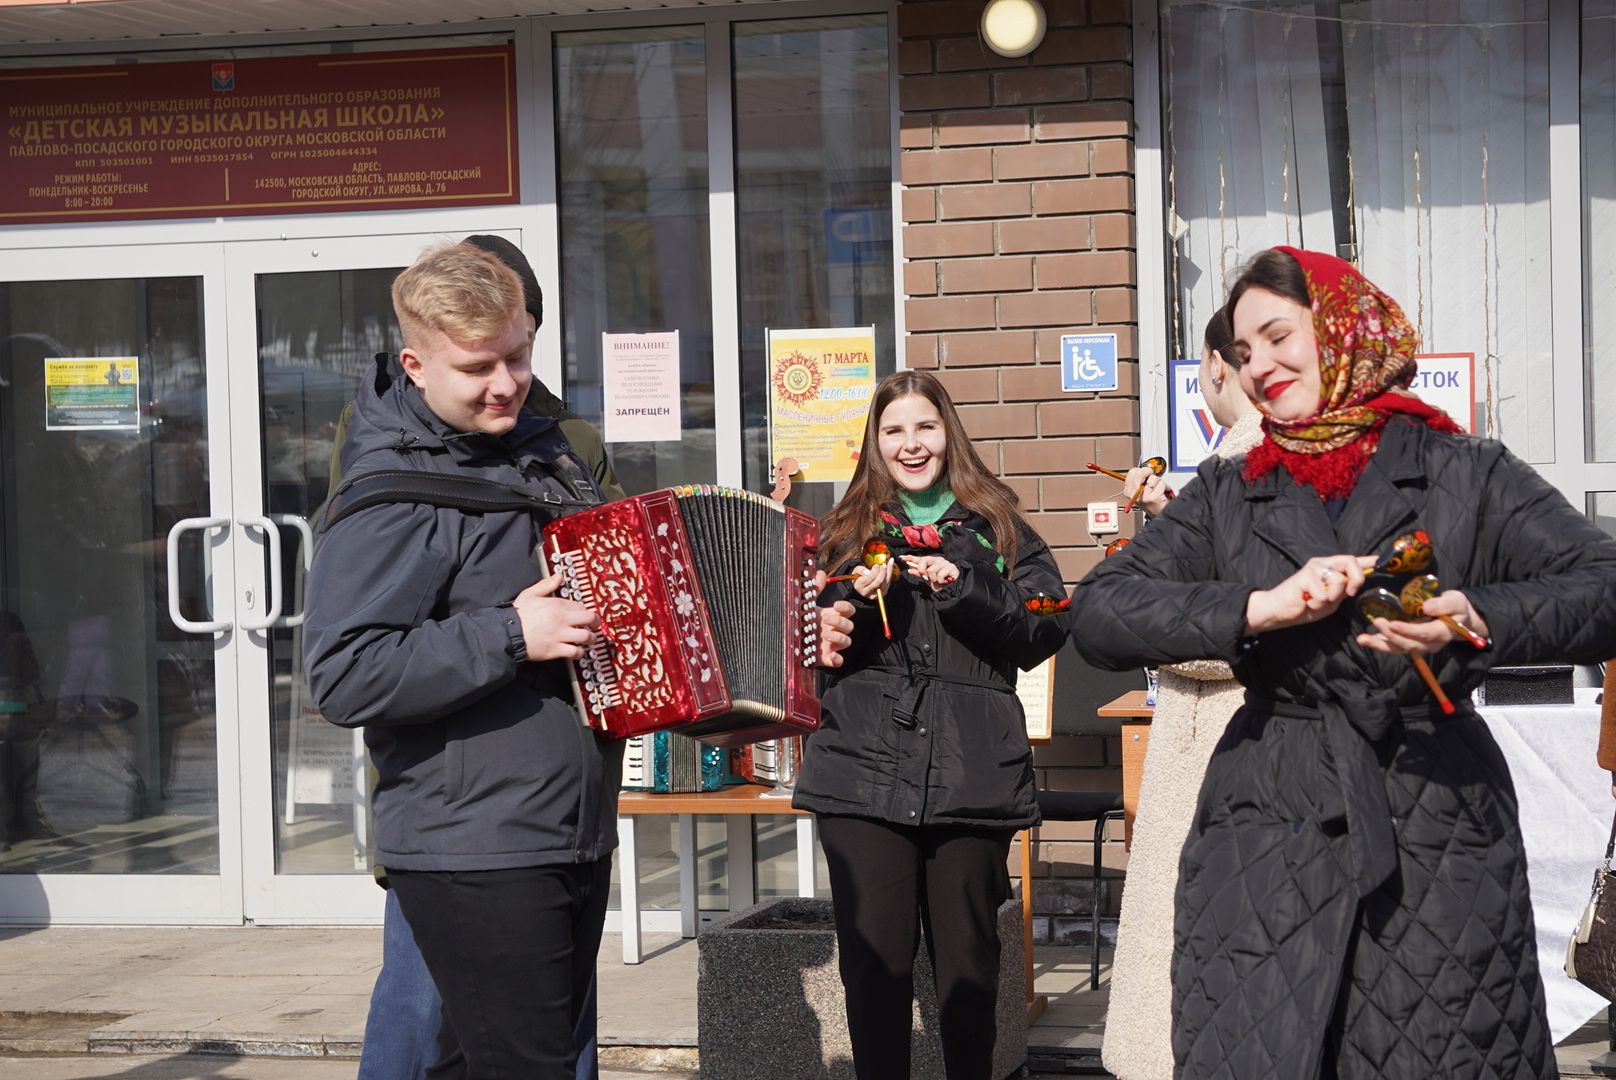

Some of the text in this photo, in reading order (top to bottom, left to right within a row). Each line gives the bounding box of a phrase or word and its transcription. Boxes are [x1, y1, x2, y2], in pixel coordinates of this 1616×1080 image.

[9, 87, 441, 118] МУНИЦИПАЛЬНОЕ УЧРЕЖДЕНИЕ ДОПОЛНИТЕЛЬНОГО ОБРАЗОВАНИЯ
[8, 103, 446, 143] «ДЕТСКАЯ МУЗЫКАЛЬНАЯ ШКОЛА»
[9, 126, 446, 157] ПАВЛОВО-ПОСАДСКОГО ГОРОДСКОГО ОКРУГА МОСКОВСКОЙ ОБЛАСТИ
[75, 159, 95, 168] КПП
[171, 155, 192, 164] ИНН
[271, 151, 297, 160] ОГРН
[352, 162, 382, 173] АДРЕС:
[55, 172, 122, 184] РЕЖИМ РАБОТЫ:
[254, 167, 481, 190] 142500, МОСКОВСКАЯ ОБЛАСТЬ, ПАВЛОВО-ПОСАДСКИЙ
[29, 183, 149, 198] ПОНЕДЕЛЬНИК-ВОСКРЕСЕНЬЕ
[292, 183, 446, 199] ГОРОДСКОЙ ОКРУГ, УЛ. КИРОВА, Д. 76
[65, 198, 83, 208] 8:00
[91, 197, 113, 207] 20:00
[613, 341, 669, 351] ВНИМАНИЕ!
[822, 352, 869, 364] 17 МАРТА
[615, 407, 670, 417] ЗАПРЕЩЁН
